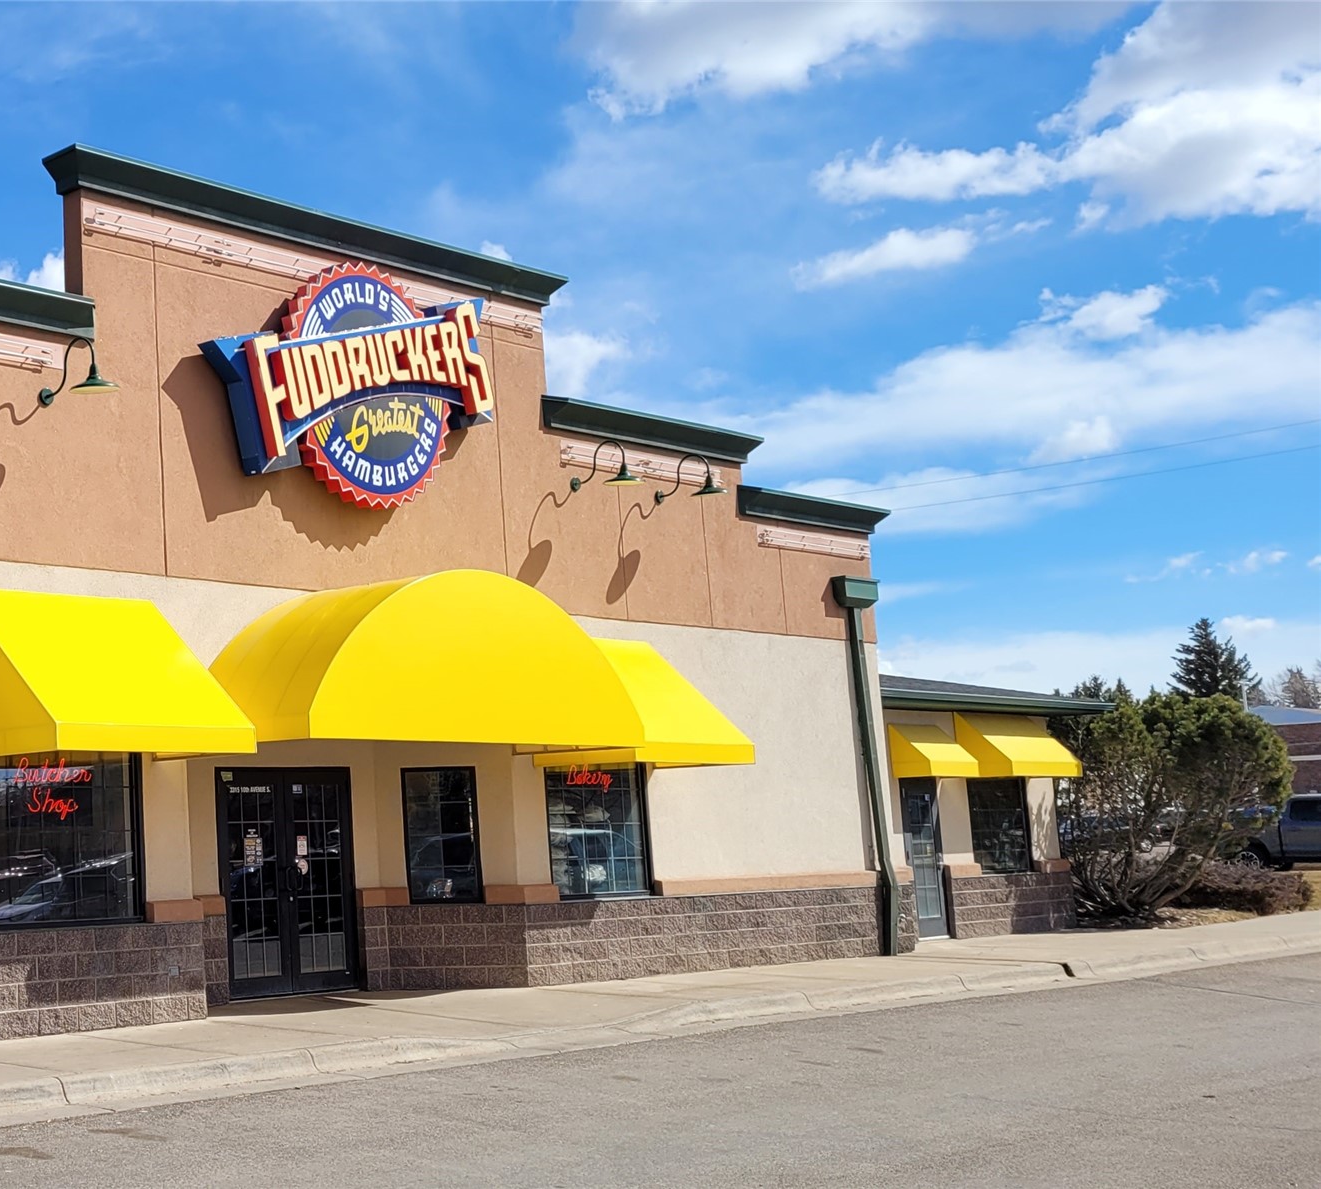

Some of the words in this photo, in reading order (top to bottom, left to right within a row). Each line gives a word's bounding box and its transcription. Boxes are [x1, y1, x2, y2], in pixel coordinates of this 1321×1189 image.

[319, 282, 390, 320] WORLD'S
[253, 302, 494, 458] FUDDRUCKERS
[345, 397, 425, 453] Greatest
[329, 417, 437, 487] HAMBURGERS
[13, 756, 92, 783] Butcher
[566, 763, 613, 793] Bakery
[26, 787, 79, 820] Shop
